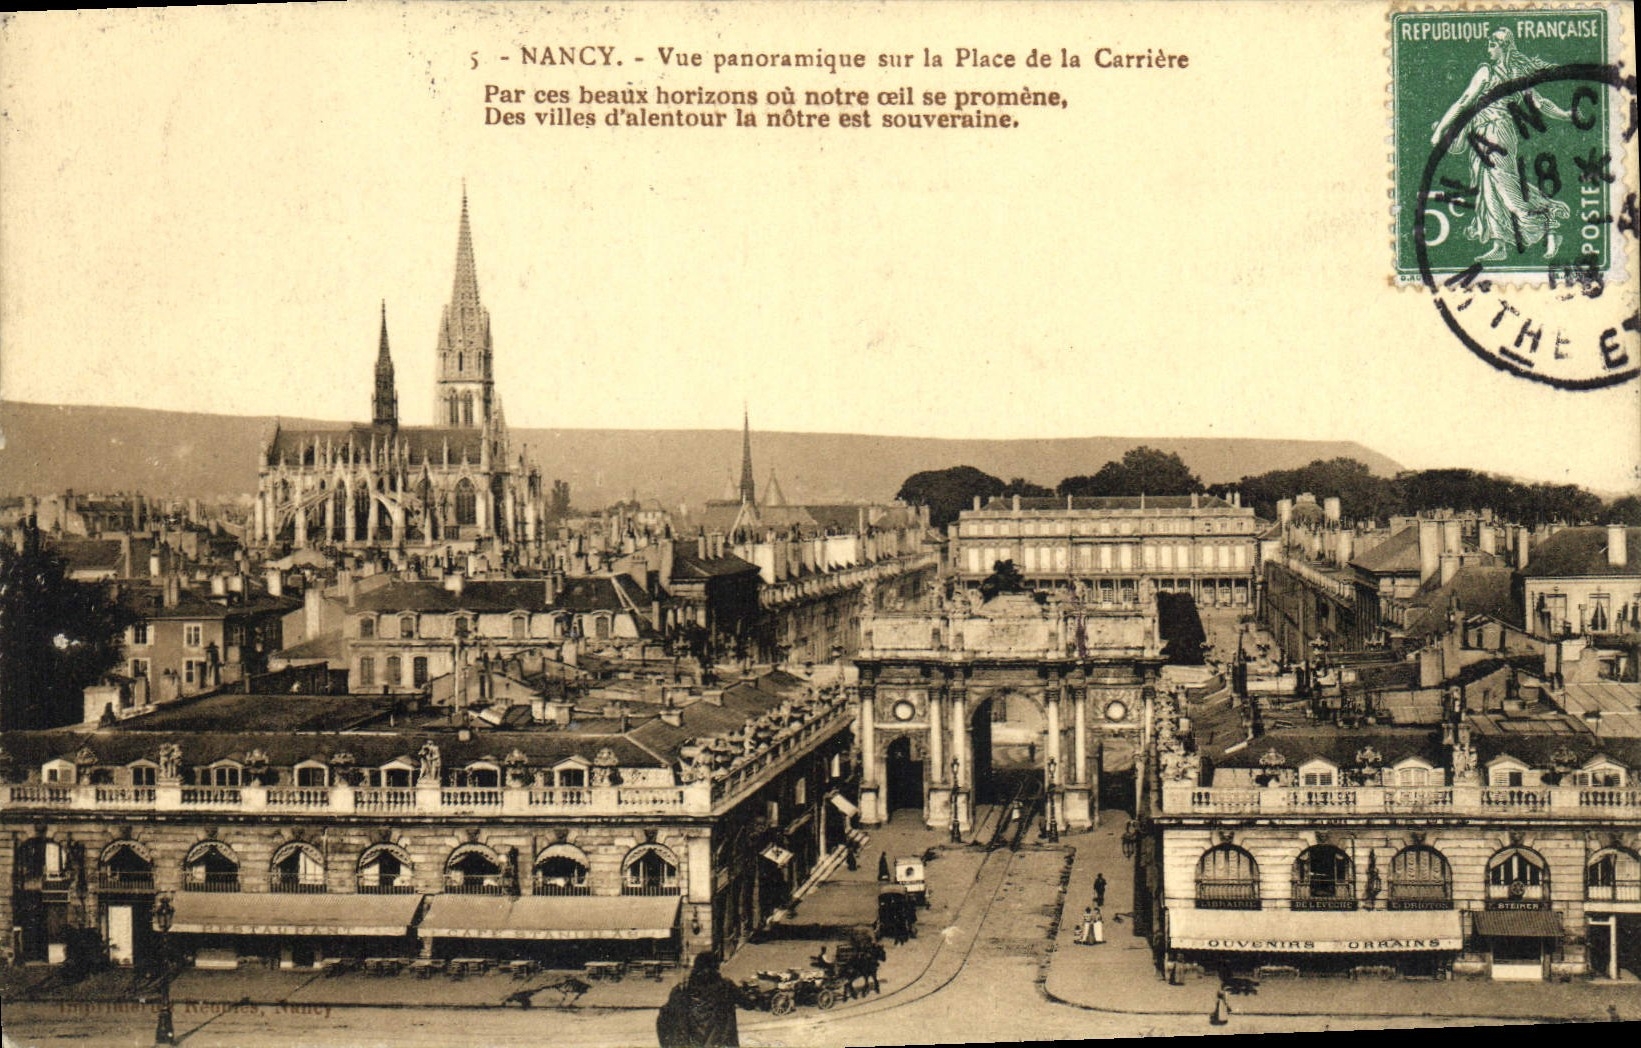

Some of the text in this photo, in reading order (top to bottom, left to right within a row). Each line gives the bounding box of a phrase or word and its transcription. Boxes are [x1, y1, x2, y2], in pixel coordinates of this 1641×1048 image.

[1401, 19, 1599, 42] REPUBLIQUE FRANÇAISE
[1192, 938, 1316, 950] OUVENIRS
